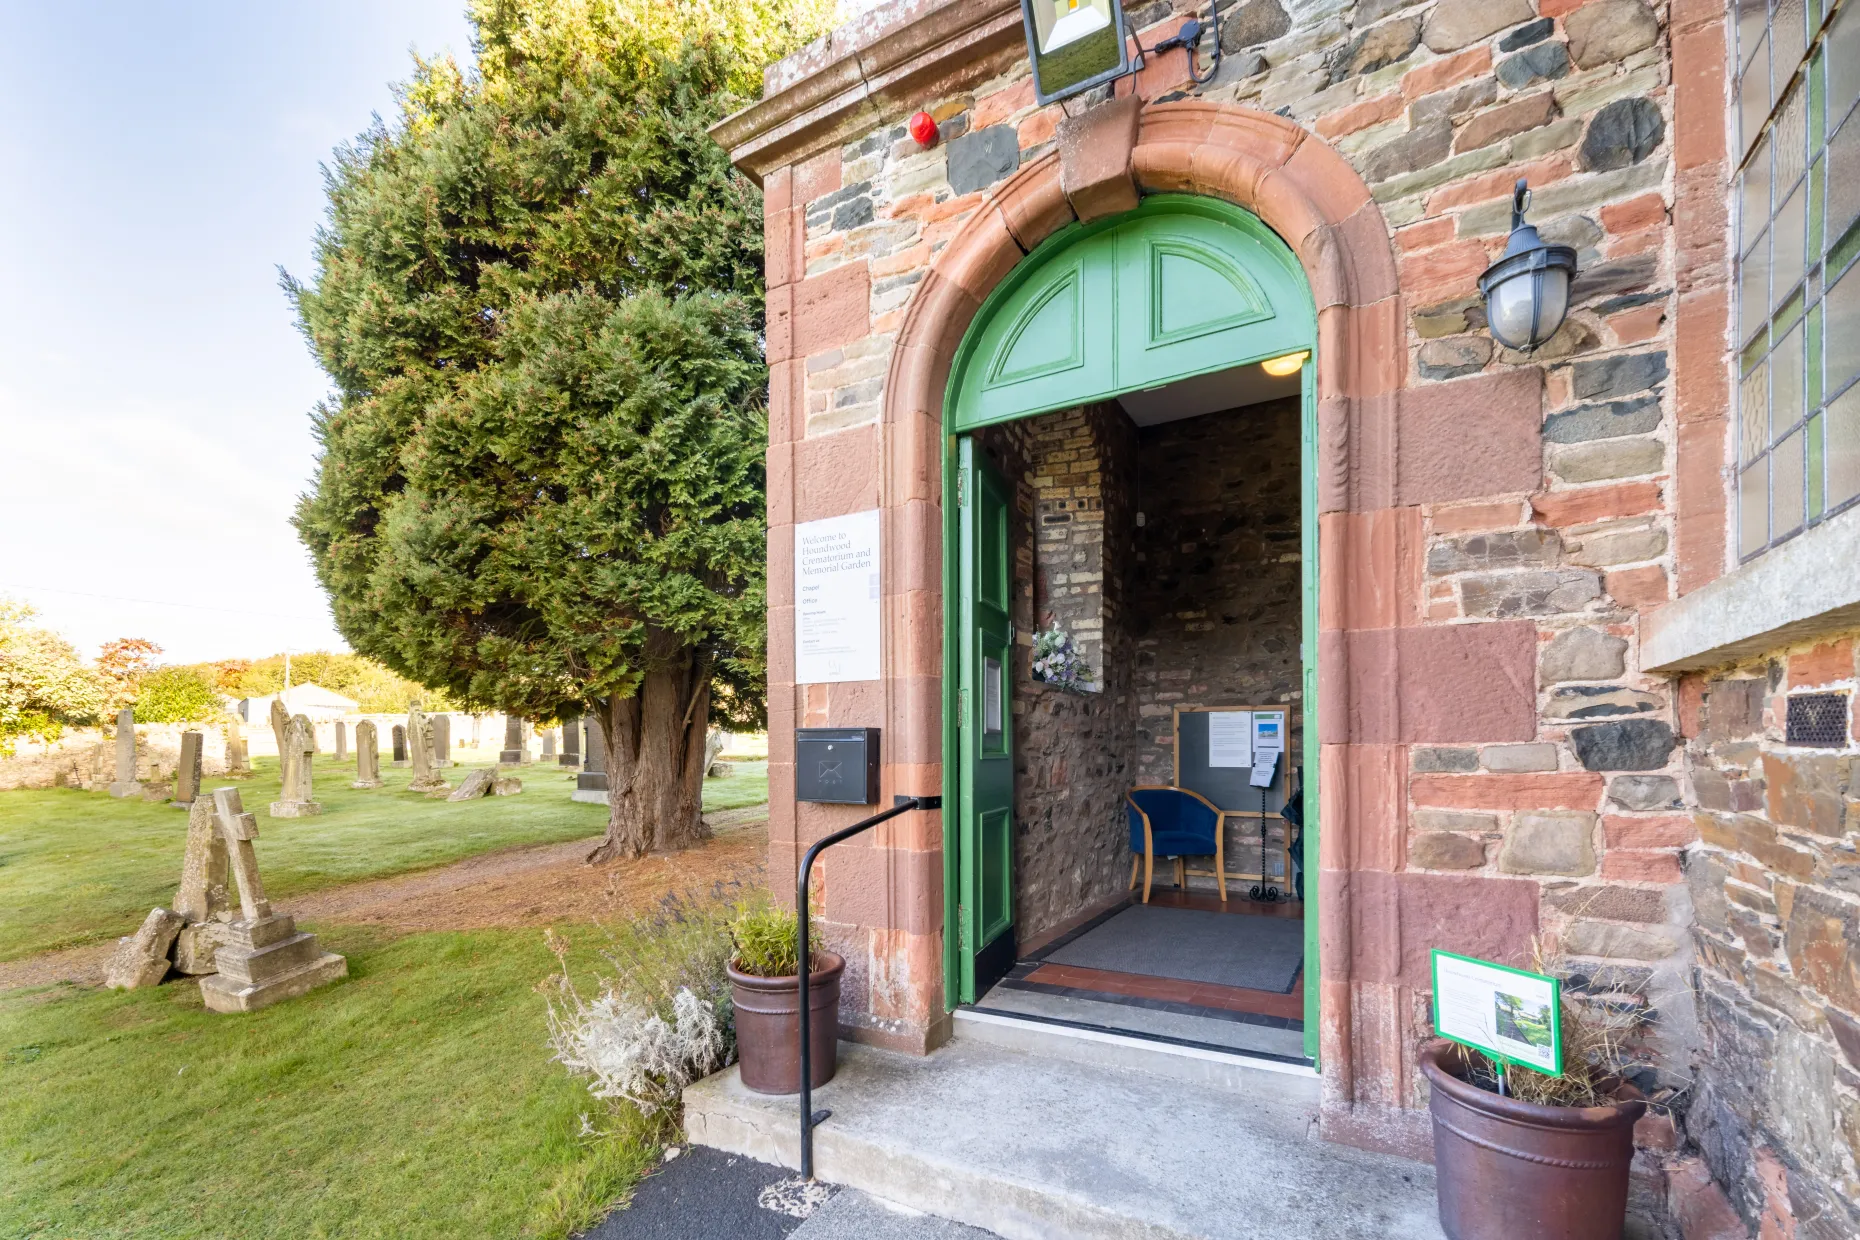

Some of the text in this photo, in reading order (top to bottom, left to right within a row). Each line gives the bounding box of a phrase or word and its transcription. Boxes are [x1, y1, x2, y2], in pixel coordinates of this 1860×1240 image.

[802, 532, 847, 545] Welcome to
[802, 539, 851, 555] Houndwood
[802, 547, 871, 566] Crematorium and
[802, 559, 871, 576] Memorial Garden
[802, 584, 820, 592] Chapel
